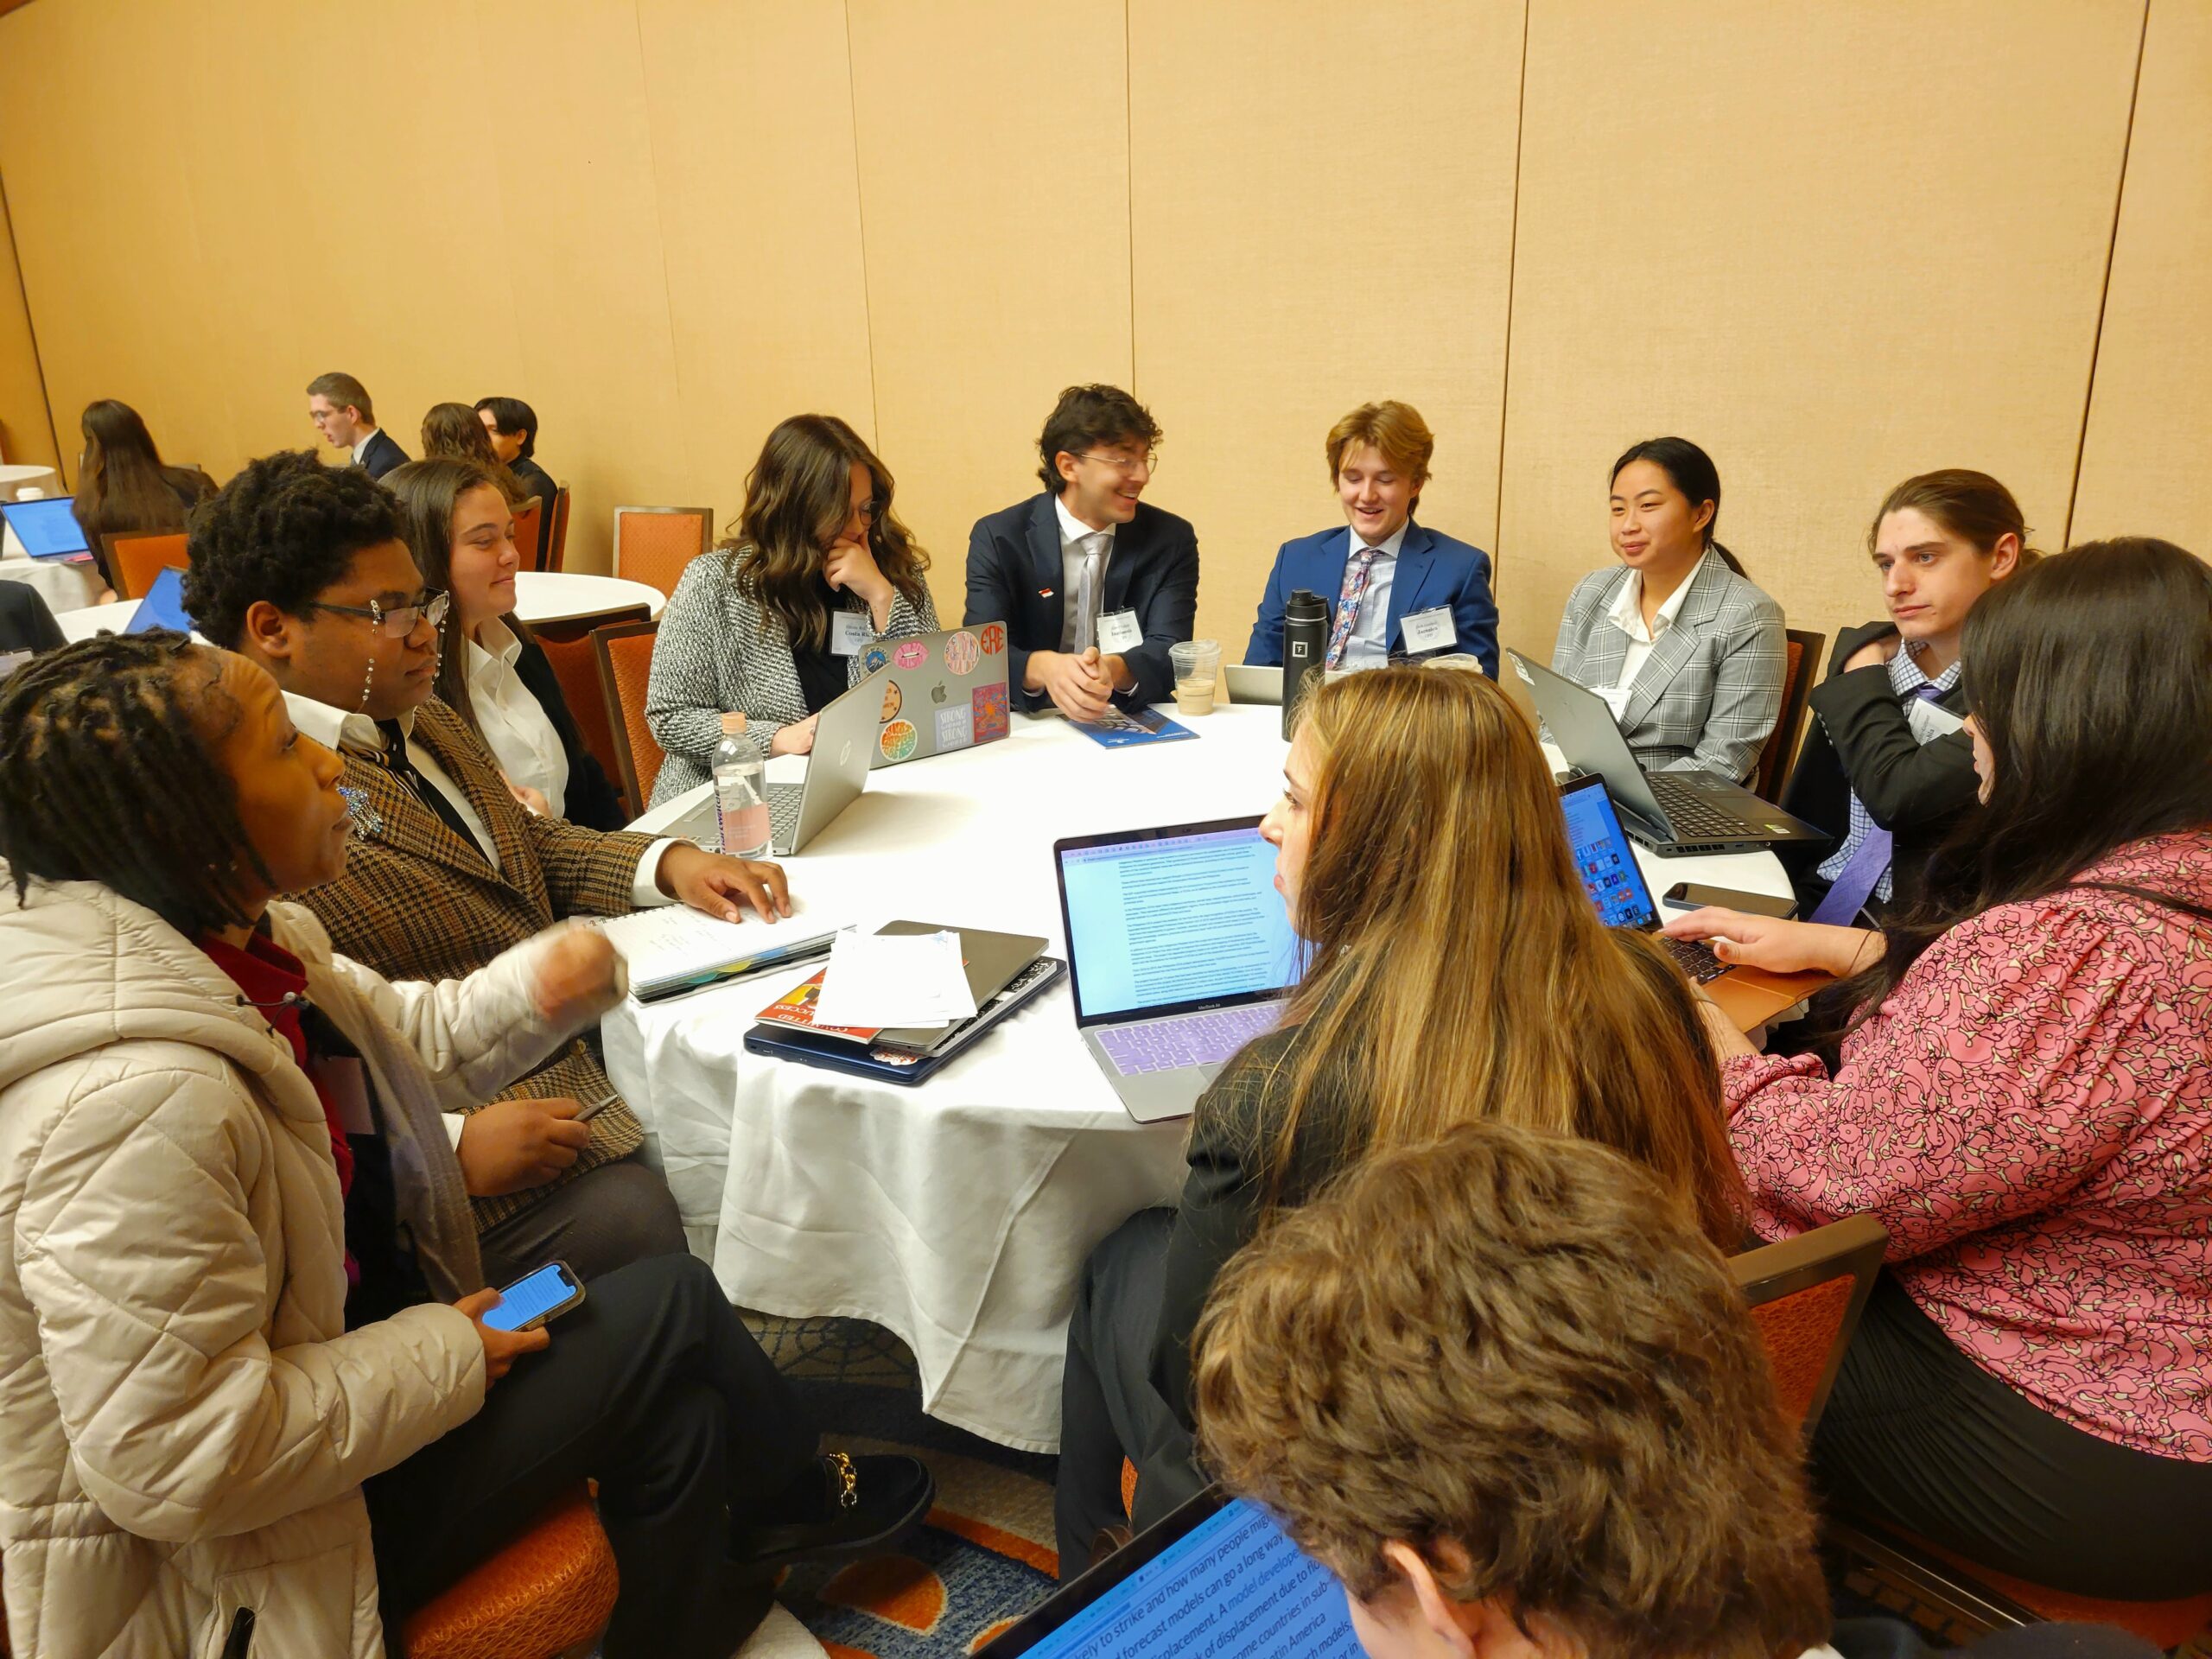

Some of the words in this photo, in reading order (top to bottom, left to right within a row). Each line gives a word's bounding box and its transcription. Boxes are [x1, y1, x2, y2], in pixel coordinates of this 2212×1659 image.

[940, 706, 966, 724] STRONG
[941, 725, 968, 743] STRONG
[715, 789, 726, 855] martwater
[773, 1004, 815, 1016] UCCESS
[1099, 1632, 1113, 1648] to
[1114, 1608, 1145, 1637] strike
[1147, 1591, 1166, 1612] and
[1166, 1574, 1189, 1594] how
[1190, 1554, 1217, 1579] many
[1217, 1528, 1249, 1562] people
[1249, 1514, 1270, 1535] mig
[1122, 1620, 1168, 1659] forecast
[1167, 1591, 1205, 1627] models
[1205, 1578, 1223, 1597] can
[1224, 1570, 1236, 1586] go
[1237, 1564, 1243, 1573] a
[1243, 1546, 1266, 1568] long
[1264, 1533, 1283, 1551] way
[1219, 1603, 1229, 1618] A
[1228, 1577, 1258, 1611] model
[1258, 1548, 1300, 1582] develope
[1205, 1639, 1216, 1658] of
[1217, 1593, 1279, 1649] displacement
[1279, 1578, 1296, 1597] due
[1296, 1569, 1307, 1584] to
[1306, 1559, 1320, 1575] flo
[1258, 1604, 1301, 1644] countries
[1302, 1594, 1312, 1608] in
[1289, 1612, 1326, 1649] America
[1349, 1642, 1358, 1655] in
